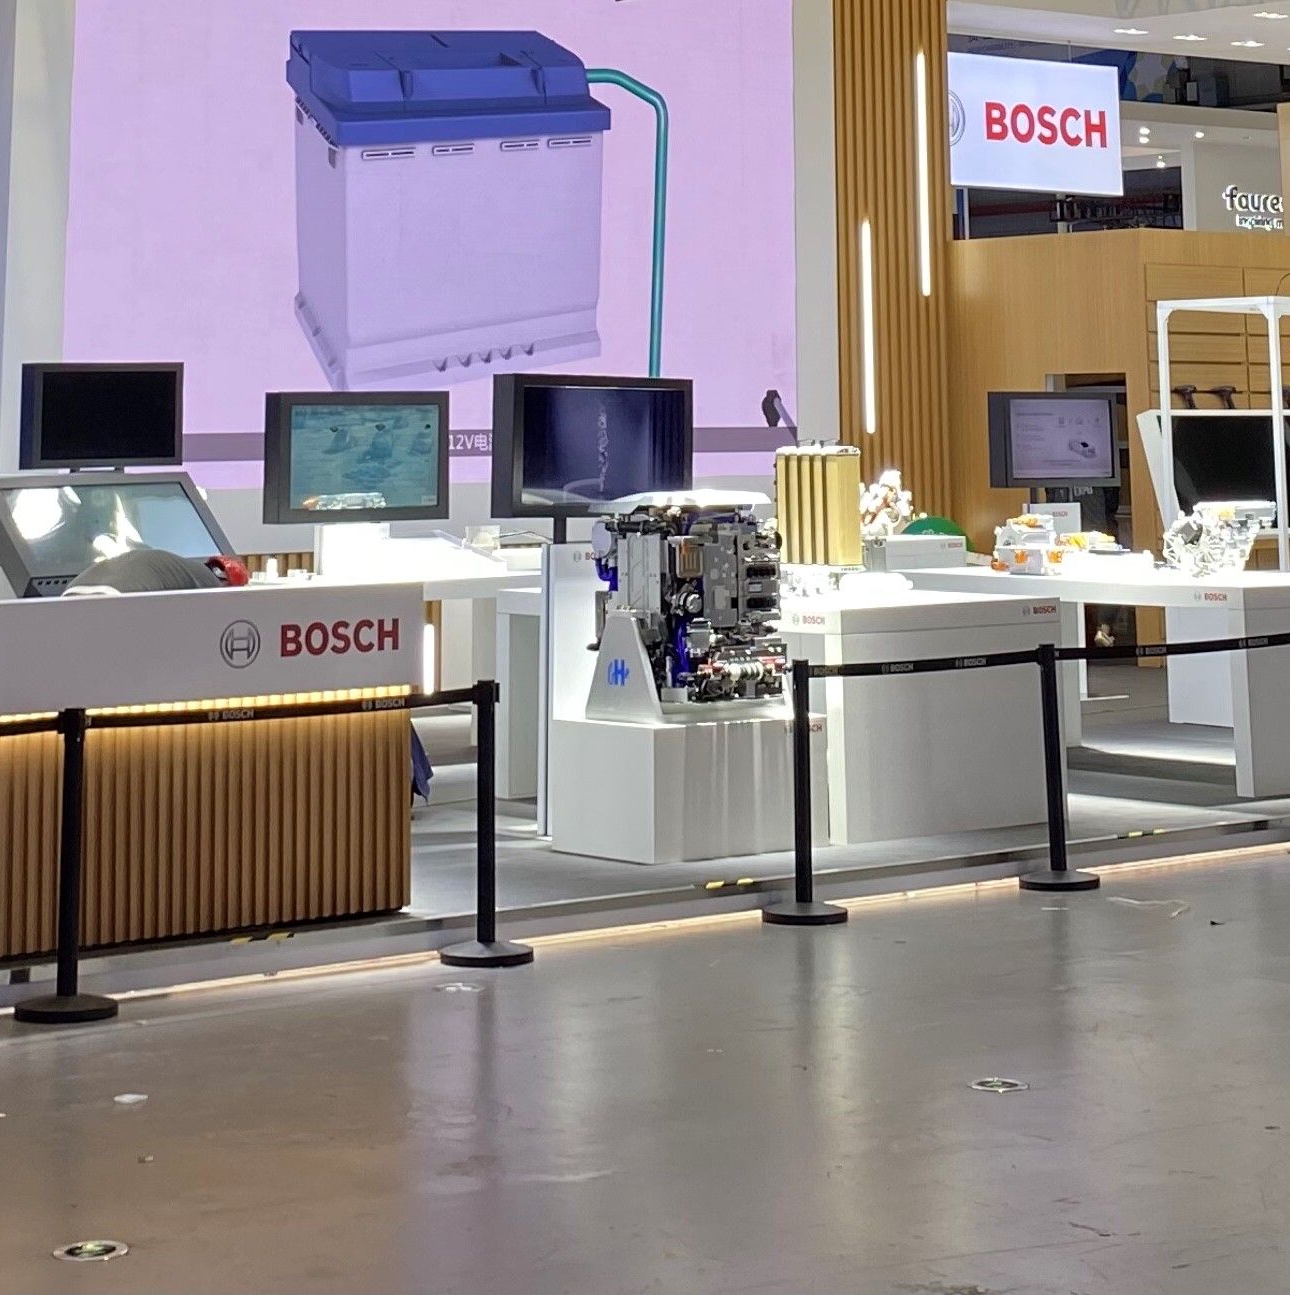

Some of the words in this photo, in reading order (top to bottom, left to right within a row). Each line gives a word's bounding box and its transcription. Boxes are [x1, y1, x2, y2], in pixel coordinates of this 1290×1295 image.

[984, 101, 1108, 148] BOSCH
[1221, 184, 1284, 214] faure
[449, 432, 493, 452] 12V电
[279, 617, 400, 658] BOSCH
[375, 697, 406, 710] BOSCH
